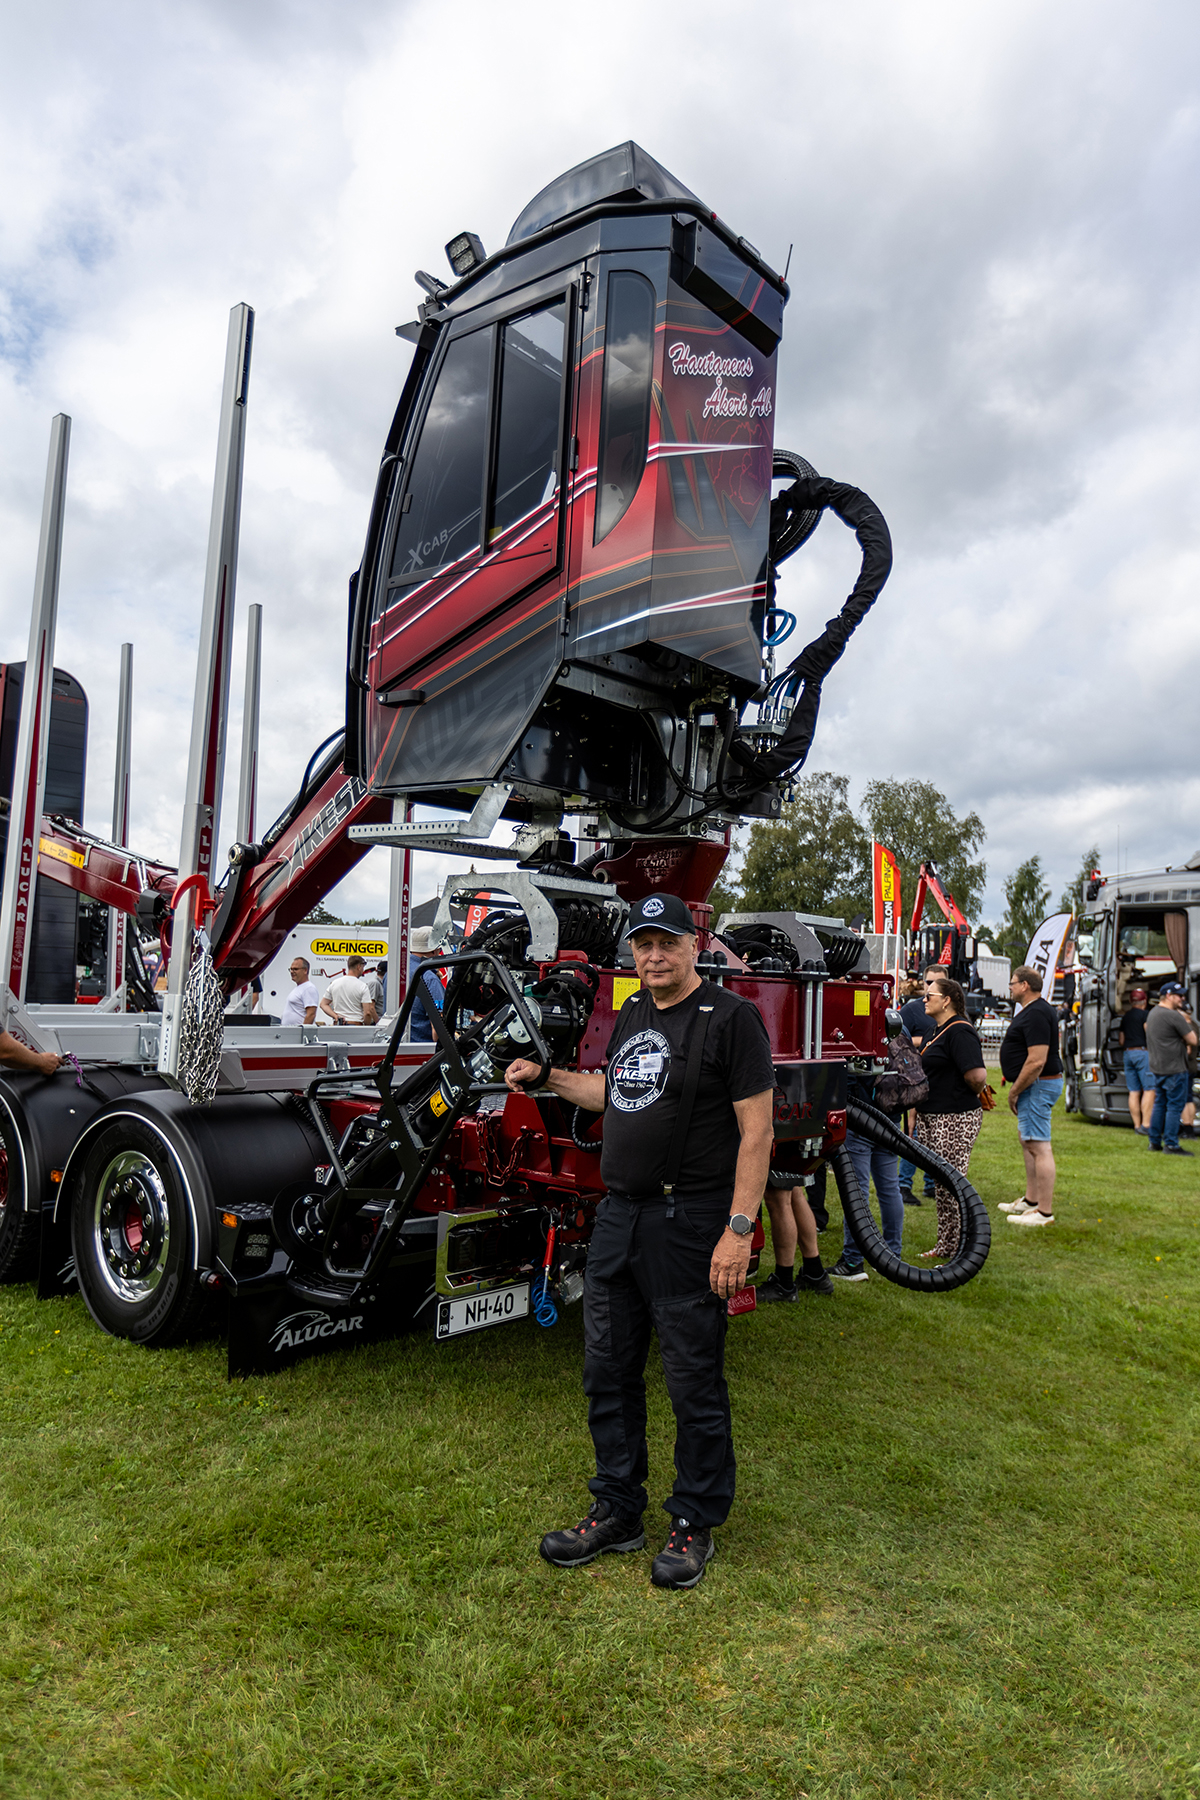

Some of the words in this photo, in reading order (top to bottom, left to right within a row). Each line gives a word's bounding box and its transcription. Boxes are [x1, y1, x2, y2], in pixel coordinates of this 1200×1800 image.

[669, 342, 753, 377] Hautanens
[702, 376, 748, 418] Åkeri
[749, 386, 772, 418] Ab
[16, 838, 33, 923] ALUCAR
[401, 884, 409, 948] ALUCAR
[316, 941, 384, 954] PALFINGER
[275, 1315, 363, 1352] ALUCAR
[440, 1324, 449, 1332] FIN
